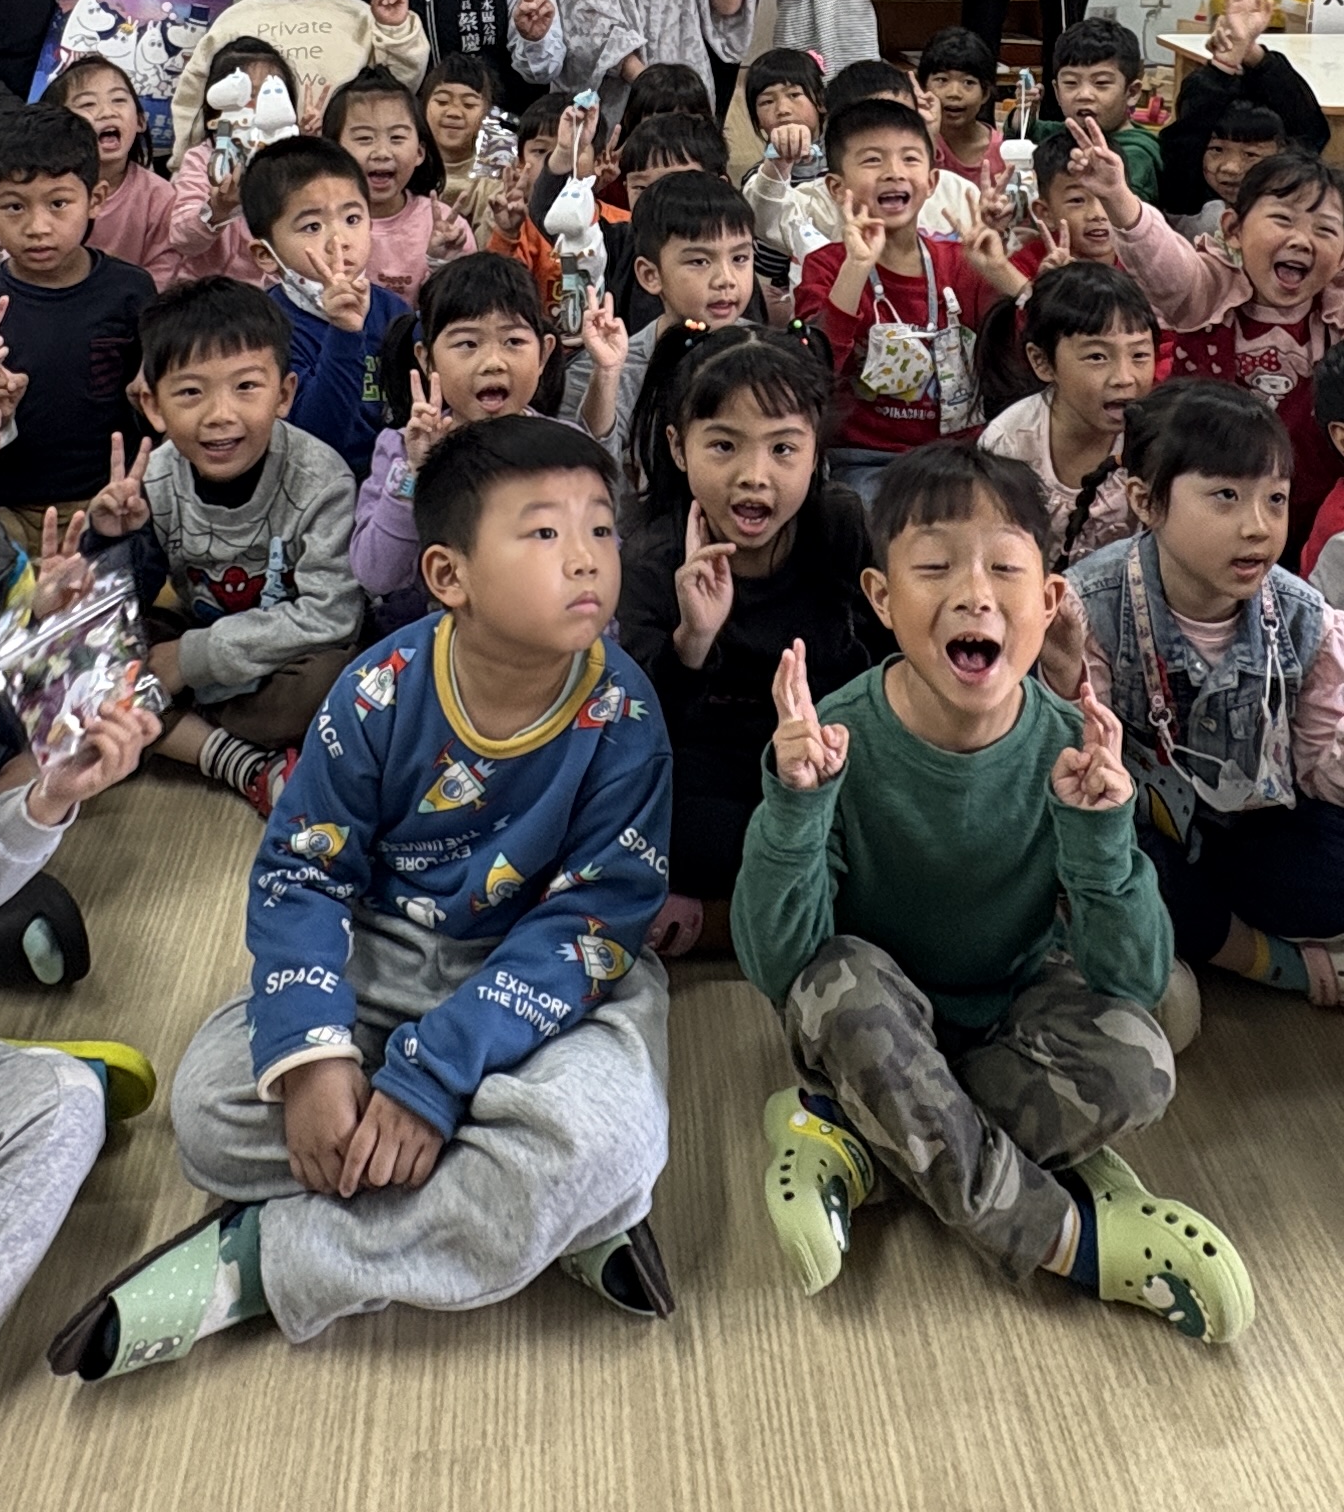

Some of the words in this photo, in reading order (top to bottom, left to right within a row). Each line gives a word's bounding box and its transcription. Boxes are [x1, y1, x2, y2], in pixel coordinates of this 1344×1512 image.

[257, 21, 332, 36] Private
[273, 44, 324, 60] ime
[619, 827, 669, 878] SPAC
[265, 966, 339, 994] SPACE
[477, 986, 511, 1008] THE
